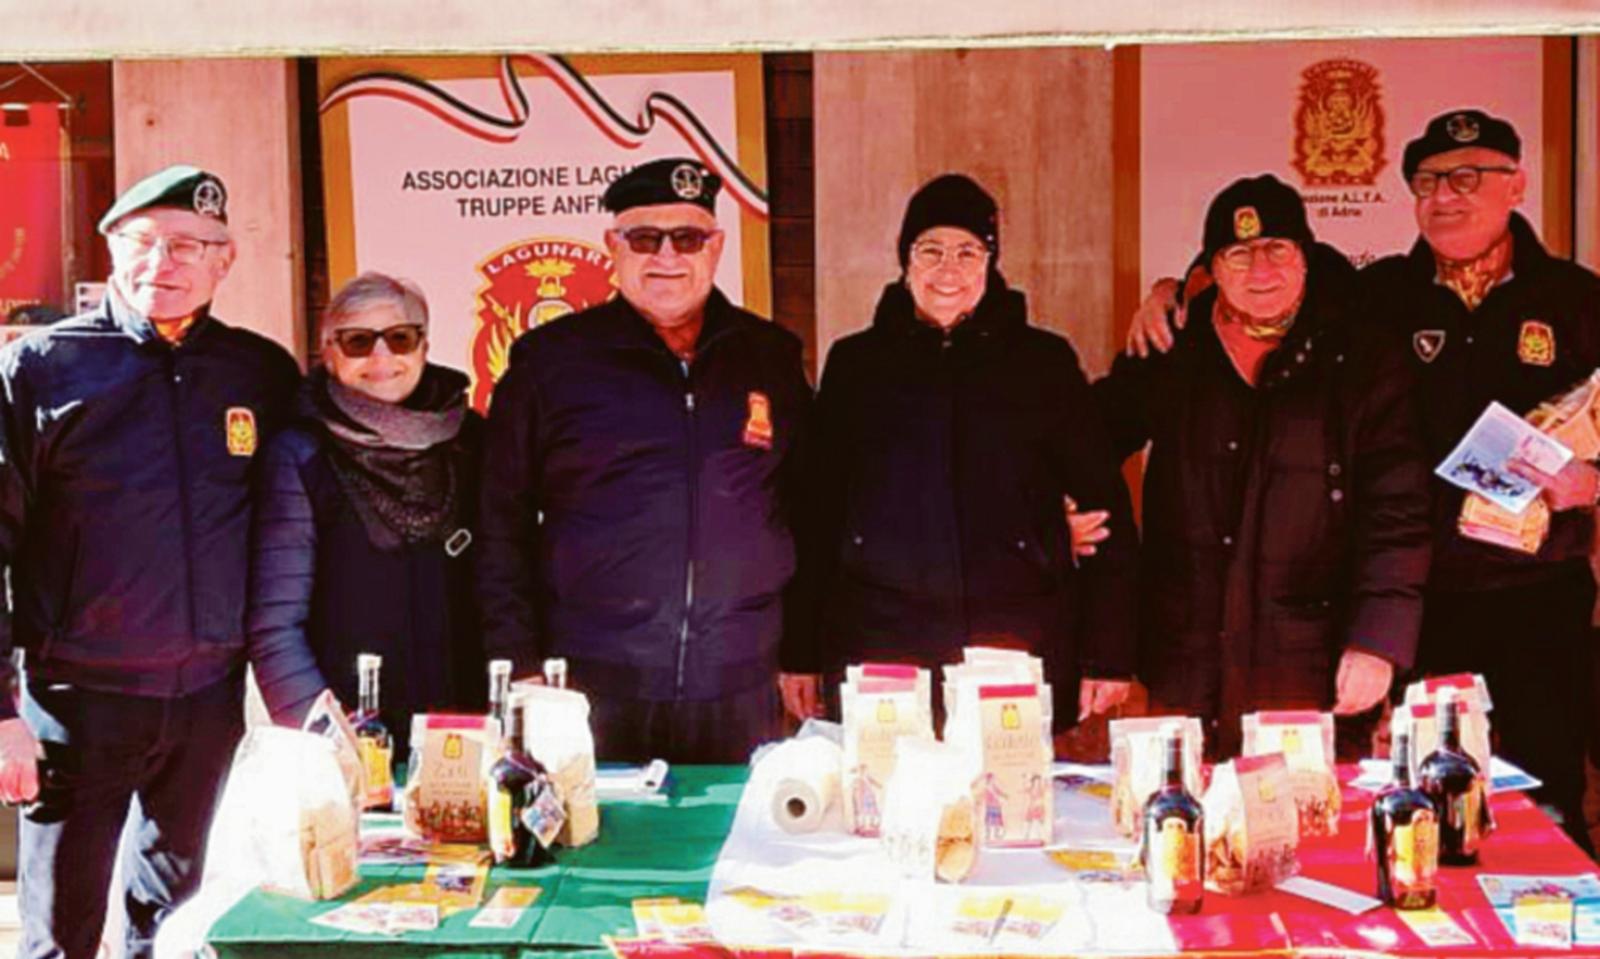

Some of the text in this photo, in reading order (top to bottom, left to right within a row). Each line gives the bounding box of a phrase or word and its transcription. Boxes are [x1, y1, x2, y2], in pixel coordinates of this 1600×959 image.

[401, 164, 625, 191] ASSOCIAZIONE LAG
[456, 193, 607, 218] TRUPPE ANFI
[486, 243, 614, 275] LAGUNARI
